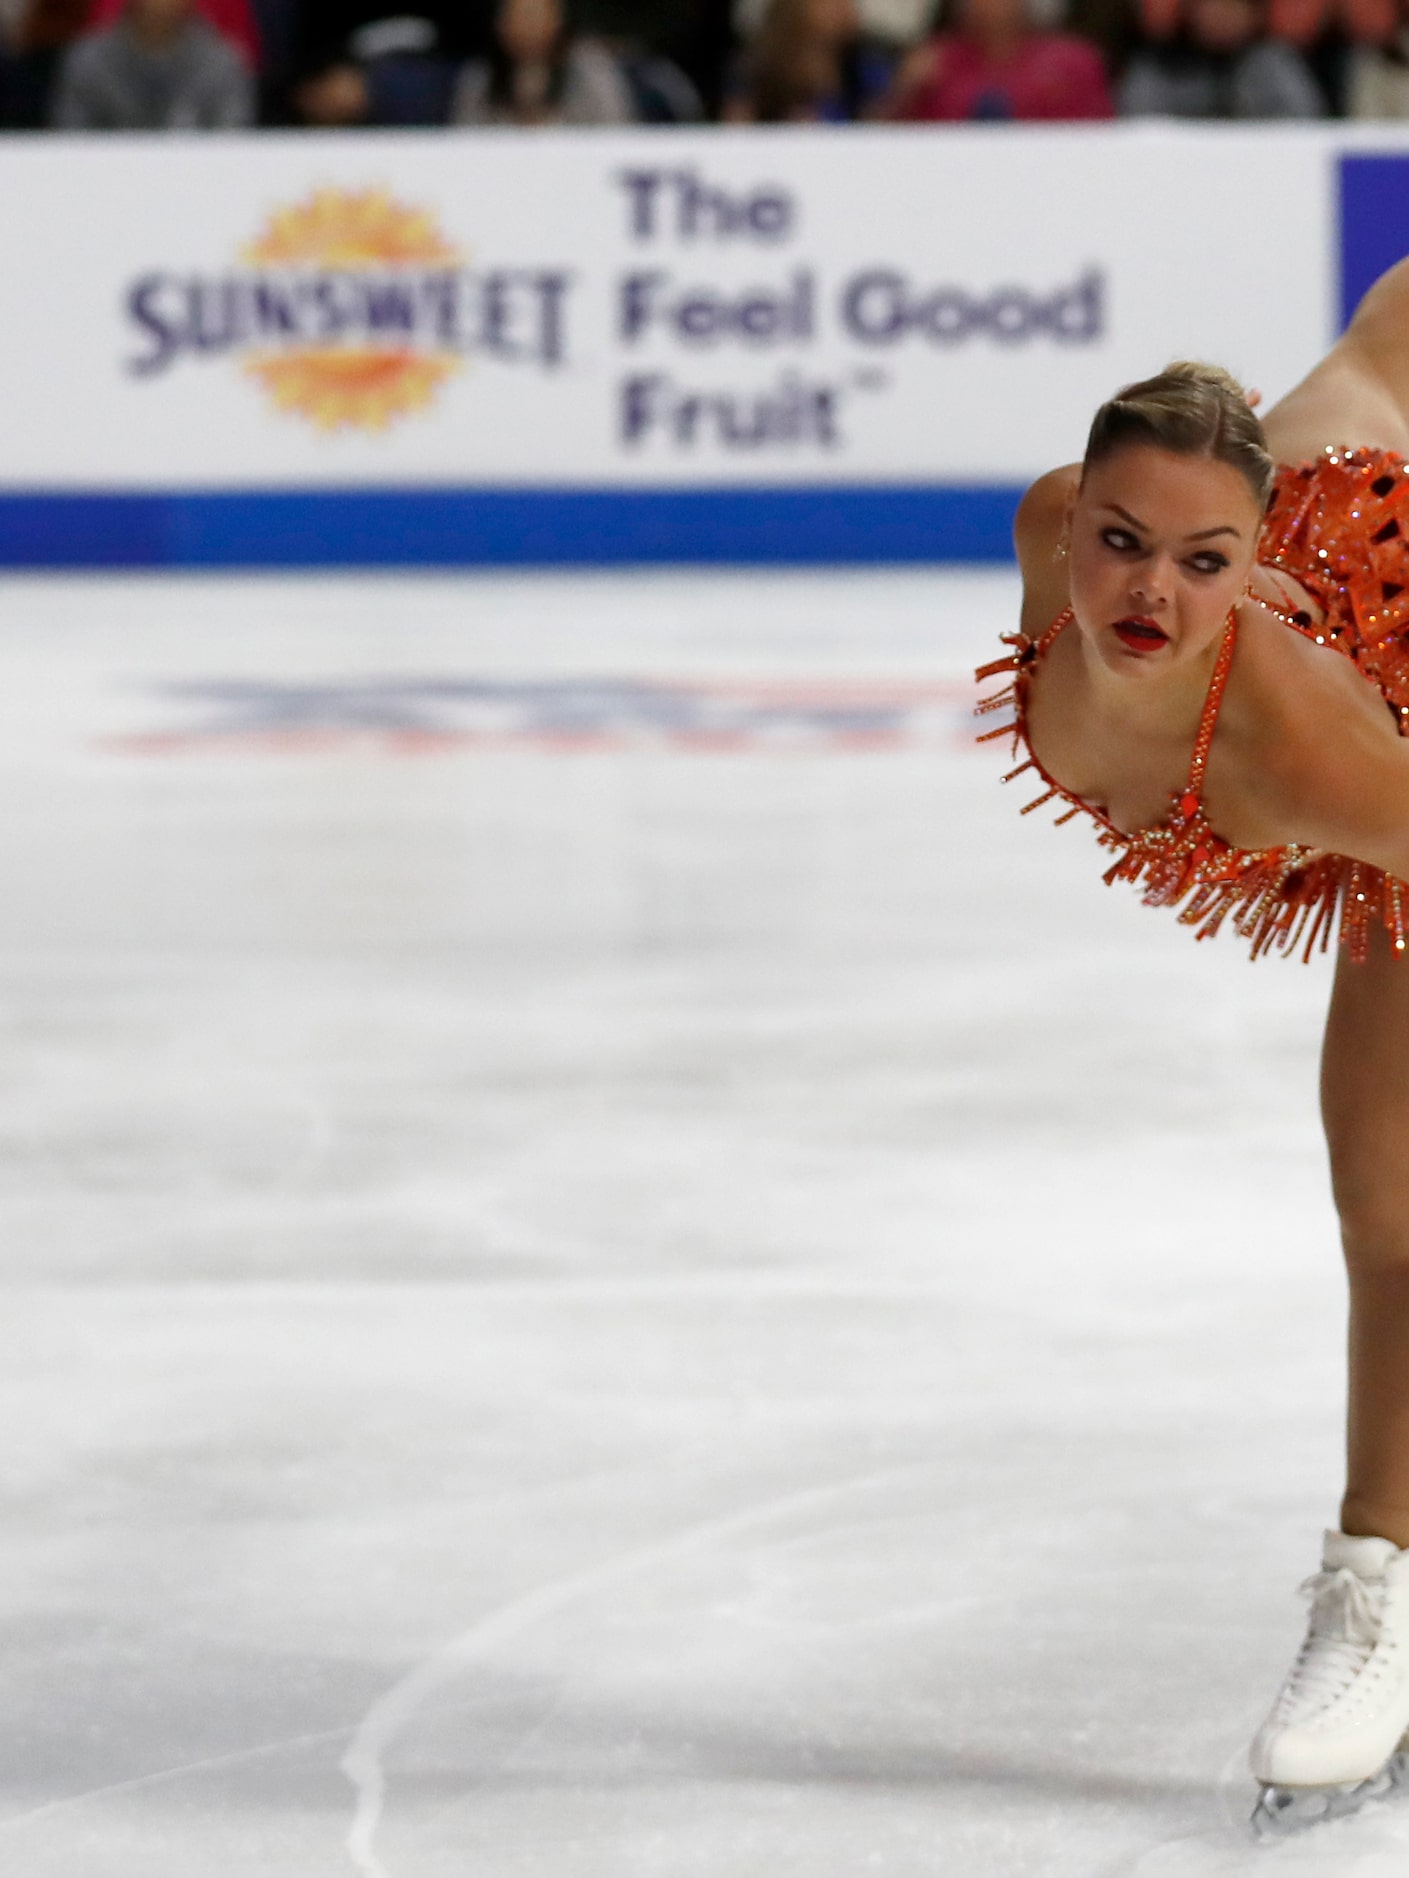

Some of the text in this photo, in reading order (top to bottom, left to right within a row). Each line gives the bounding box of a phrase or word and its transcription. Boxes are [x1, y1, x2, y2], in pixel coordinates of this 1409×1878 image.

[619, 166, 788, 244] The
[125, 268, 570, 378] SUNSWEET
[619, 265, 1105, 346] Feel Good
[619, 372, 838, 450] Fruit
